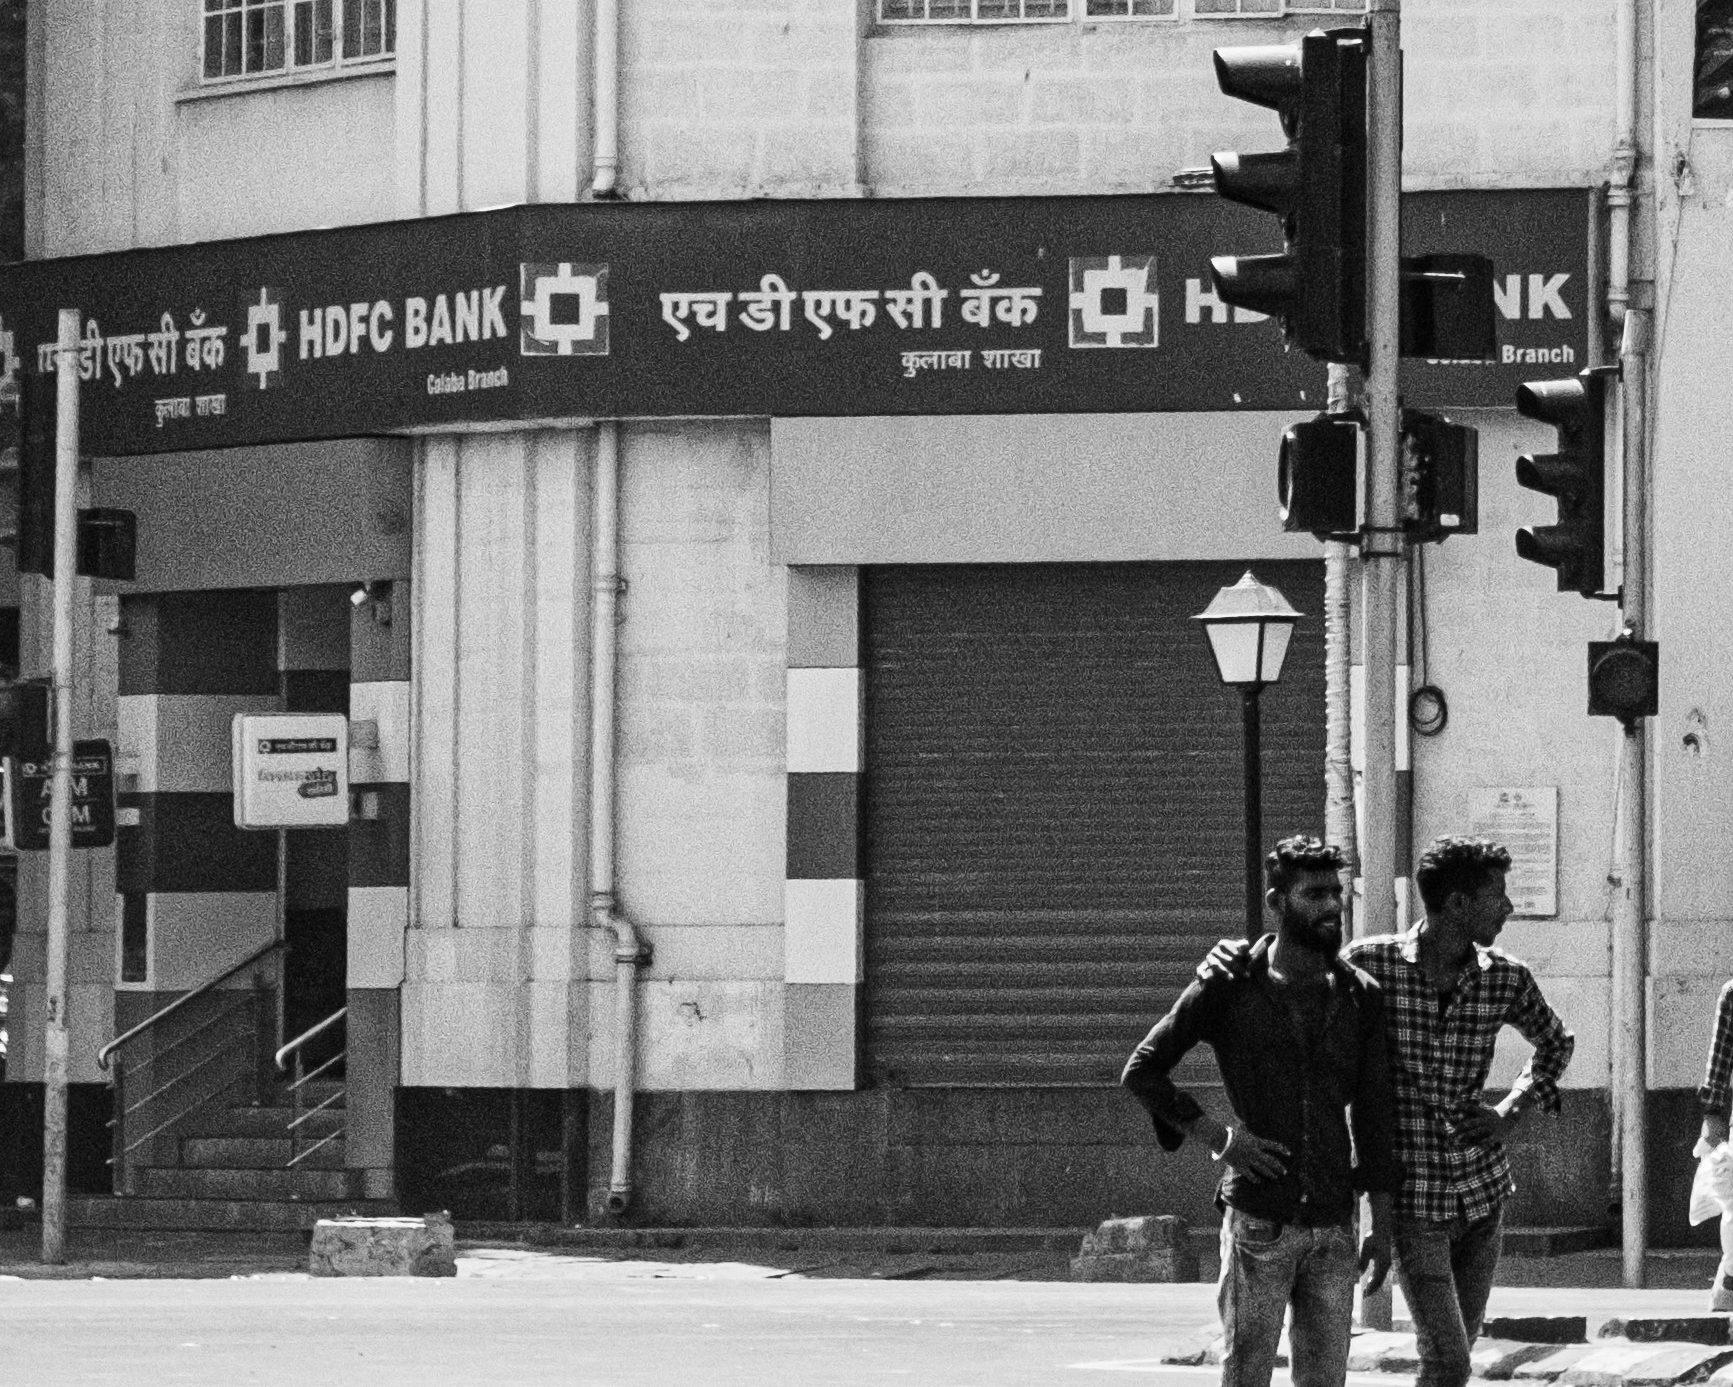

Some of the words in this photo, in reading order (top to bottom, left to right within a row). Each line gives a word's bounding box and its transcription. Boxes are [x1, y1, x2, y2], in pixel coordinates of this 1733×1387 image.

[299, 299, 394, 360] HDFC
[405, 285, 508, 349] BANK
[901, 350, 972, 378] कुलाबा
[981, 348, 1042, 369] शाखा
[1502, 345, 1575, 364] Branch
[467, 365, 509, 391] Branch
[40, 777, 88, 798] AM
